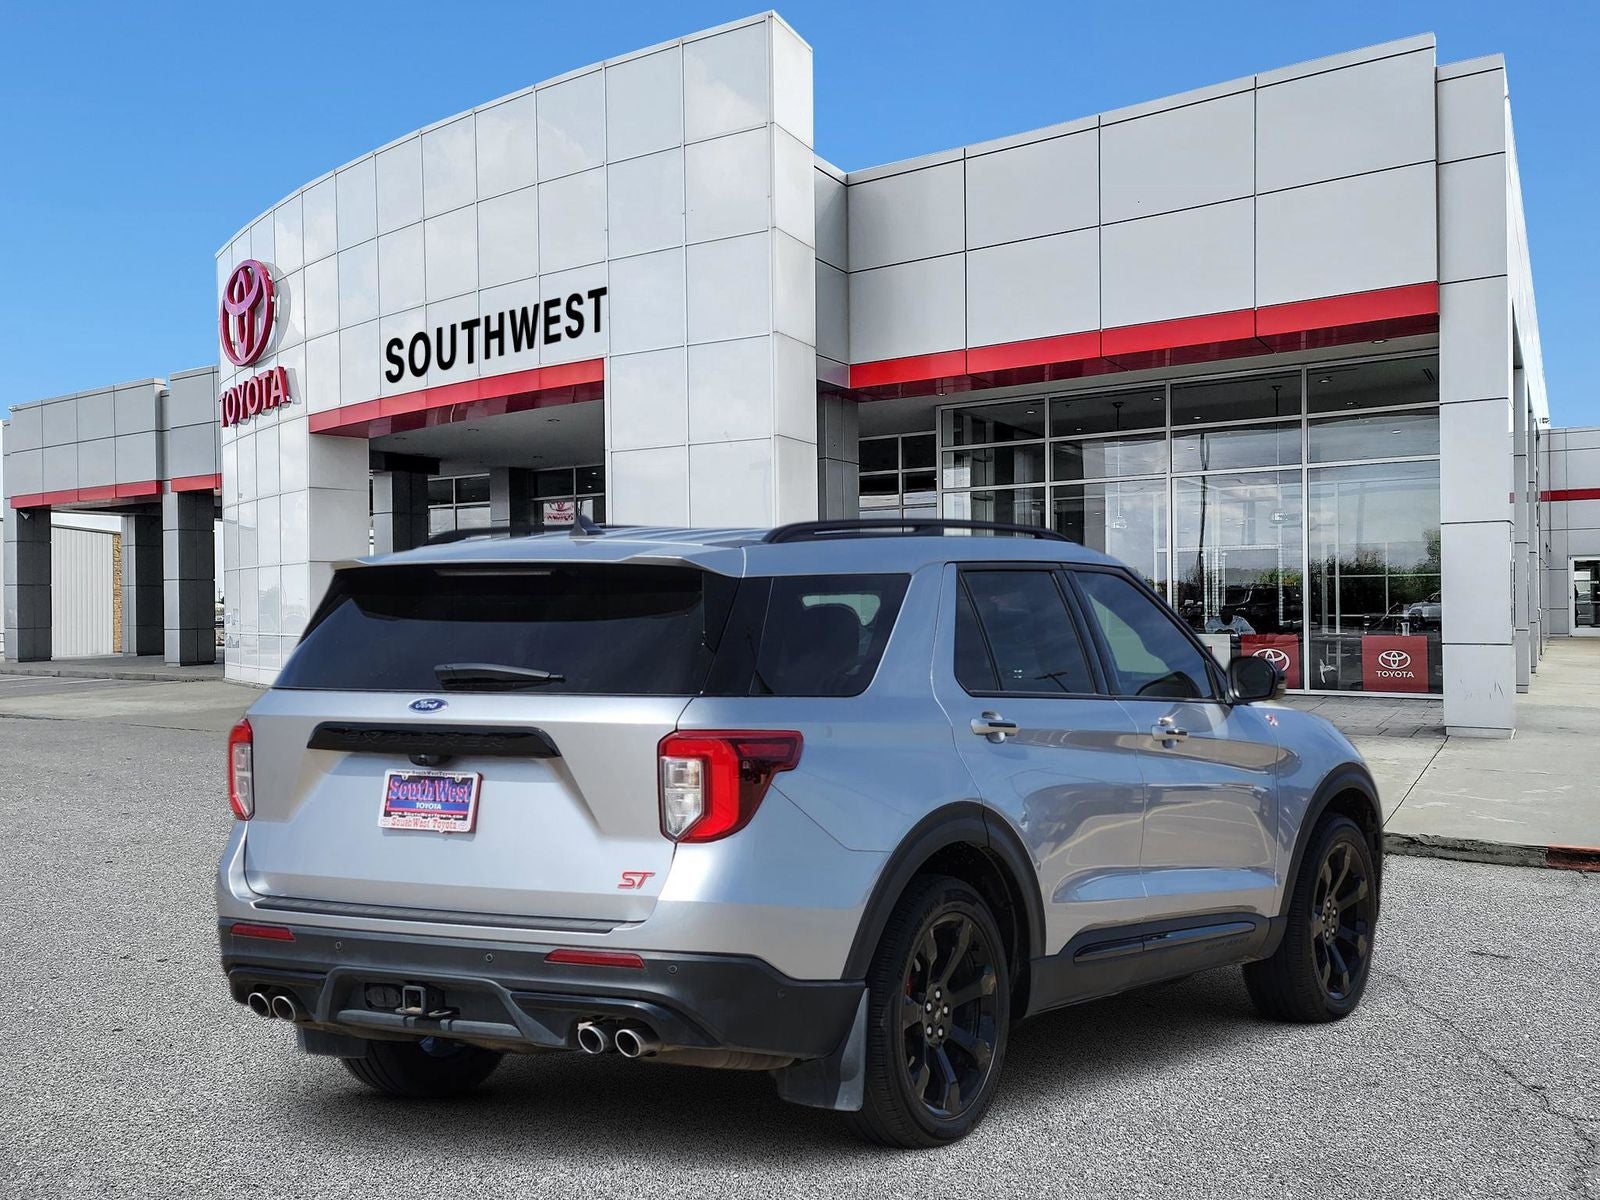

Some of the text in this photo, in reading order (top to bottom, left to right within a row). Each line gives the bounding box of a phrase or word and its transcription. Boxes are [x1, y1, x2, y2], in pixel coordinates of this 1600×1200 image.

[385, 286, 607, 383] SOUTHWEST
[219, 366, 290, 427] TOYOTA
[1375, 670, 1415, 678] TOYOTA
[415, 802, 442, 810] TOYOTA
[432, 819, 457, 830] Toyota
[617, 871, 656, 889] ST
